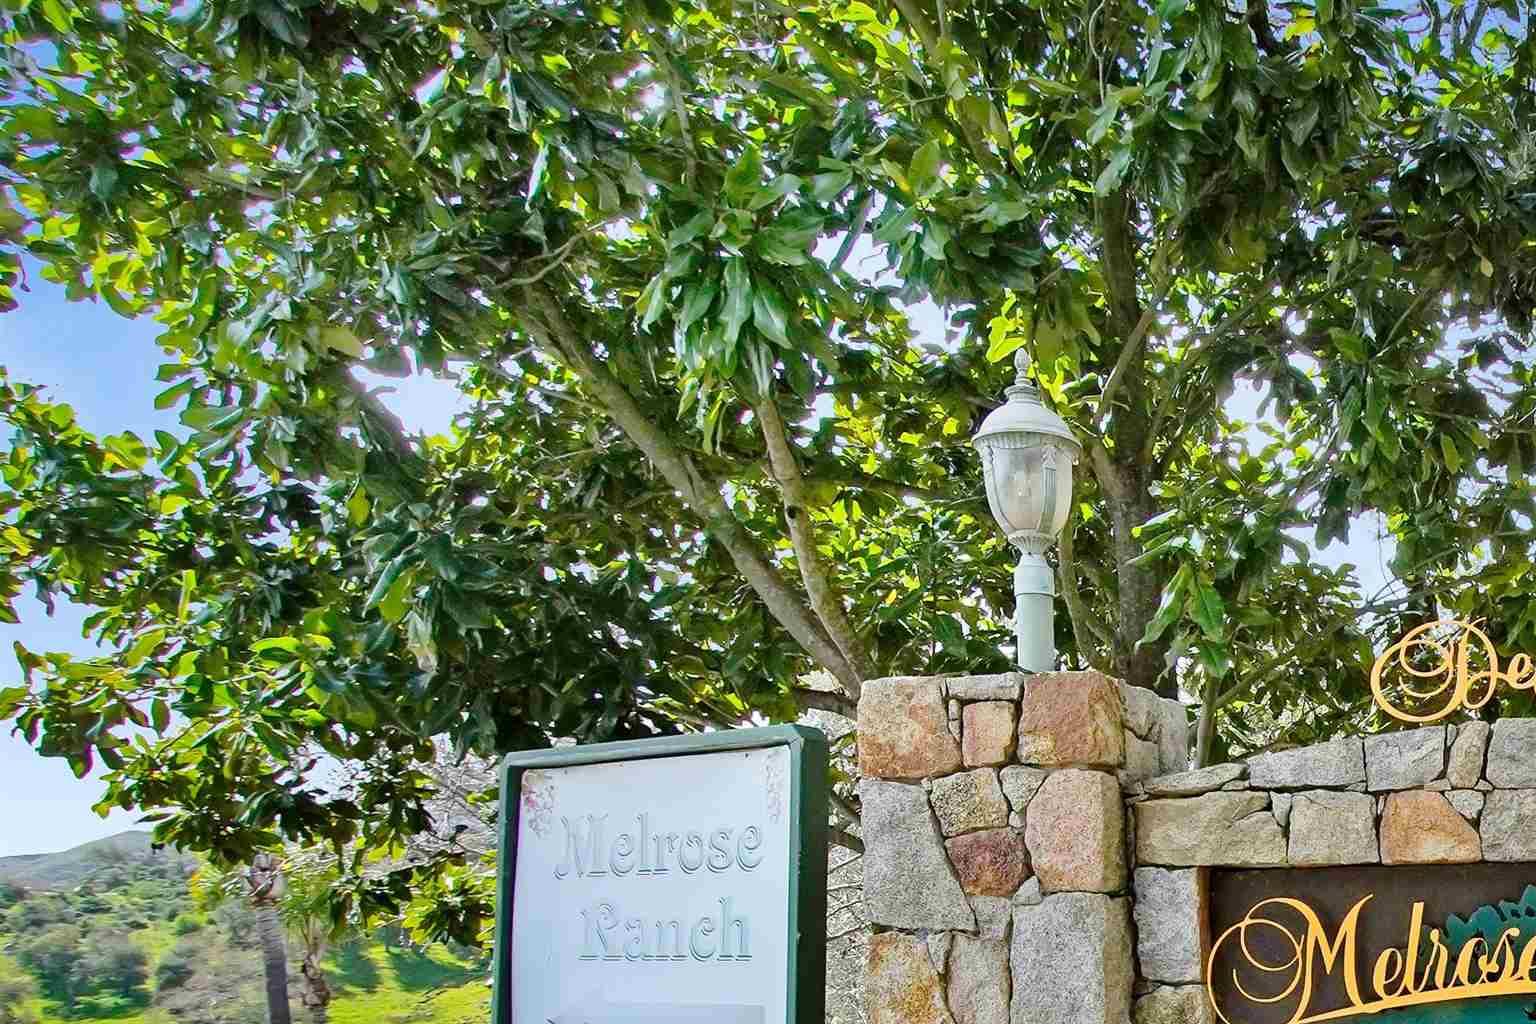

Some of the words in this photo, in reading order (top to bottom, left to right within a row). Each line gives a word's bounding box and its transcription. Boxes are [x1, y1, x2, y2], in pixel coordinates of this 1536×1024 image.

[1370, 616, 1536, 723] De
[553, 811, 766, 880] Melrose
[577, 896, 753, 962] Ranch
